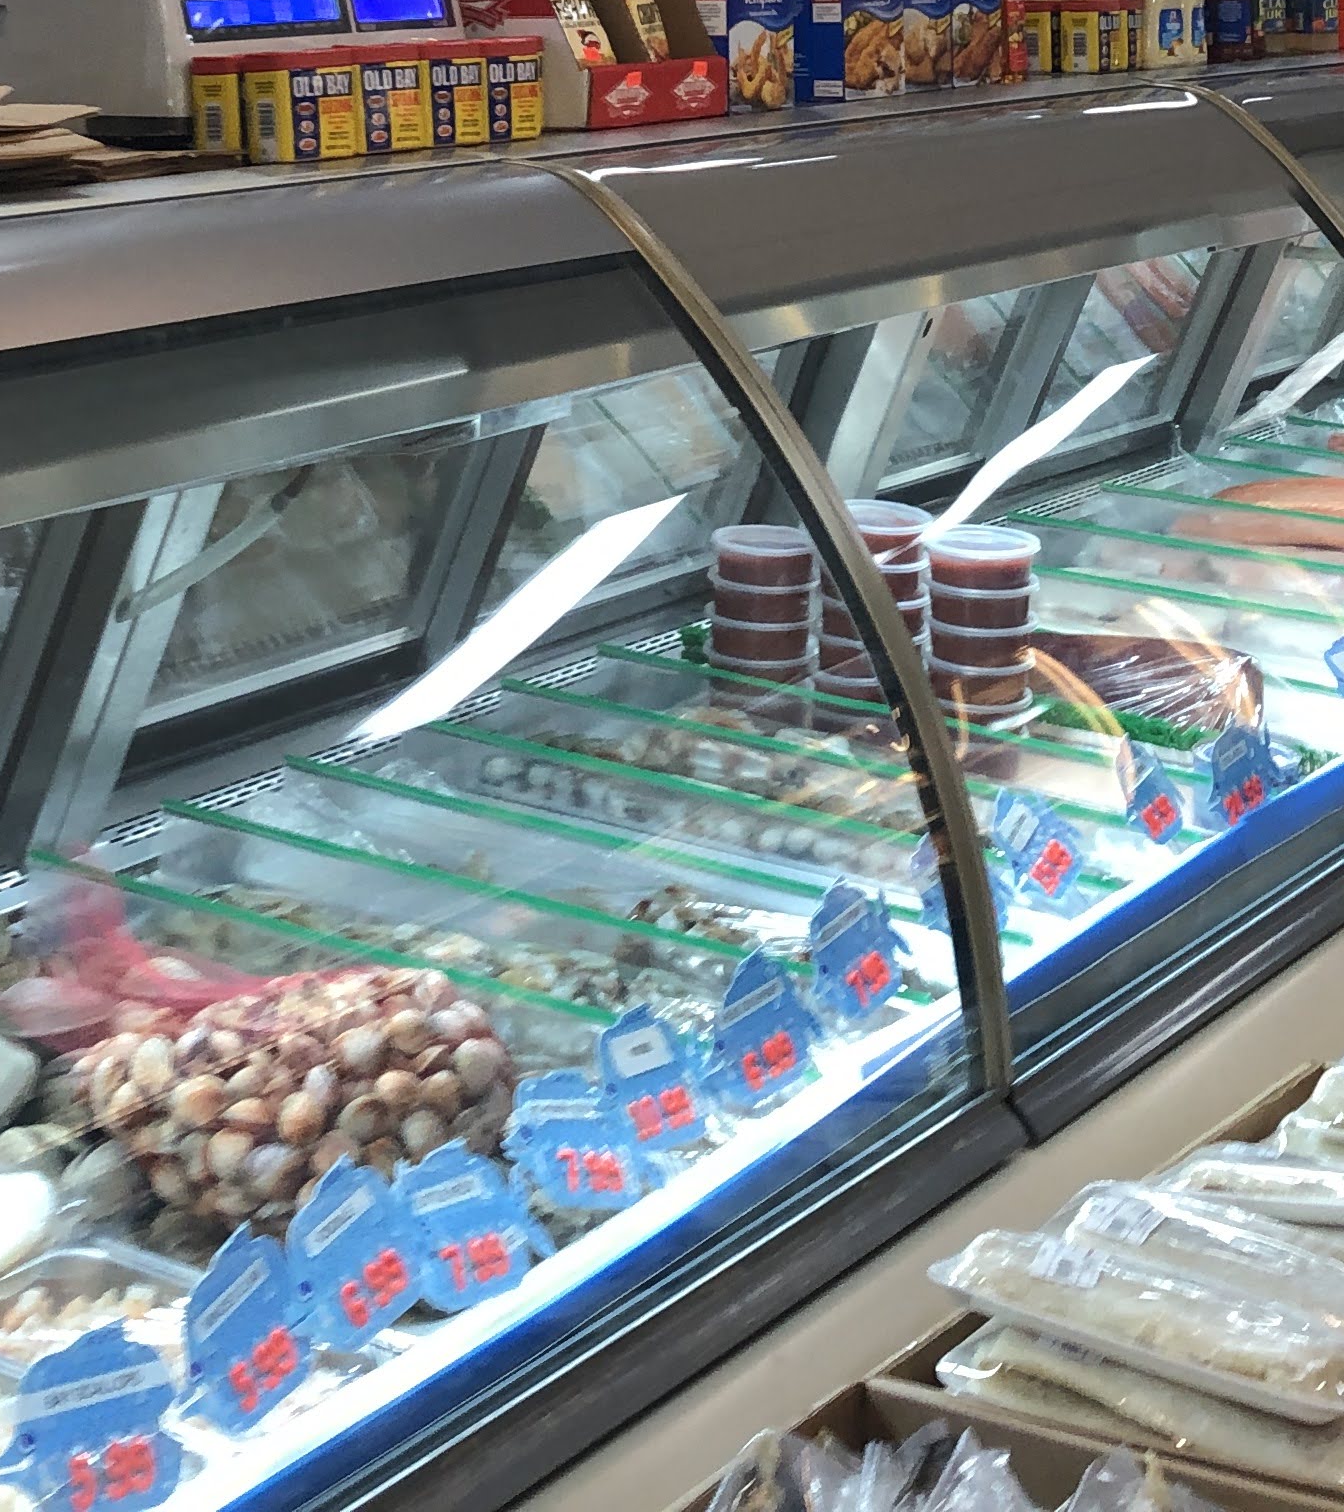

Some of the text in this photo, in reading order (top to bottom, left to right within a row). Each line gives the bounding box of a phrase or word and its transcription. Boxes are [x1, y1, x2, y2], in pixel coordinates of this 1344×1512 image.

[363, 66, 418, 91] OLD BAY
[431, 64, 482, 88] OLD BAY
[488, 59, 538, 83] OLD BAY
[292, 72, 351, 97] OLD BAY
